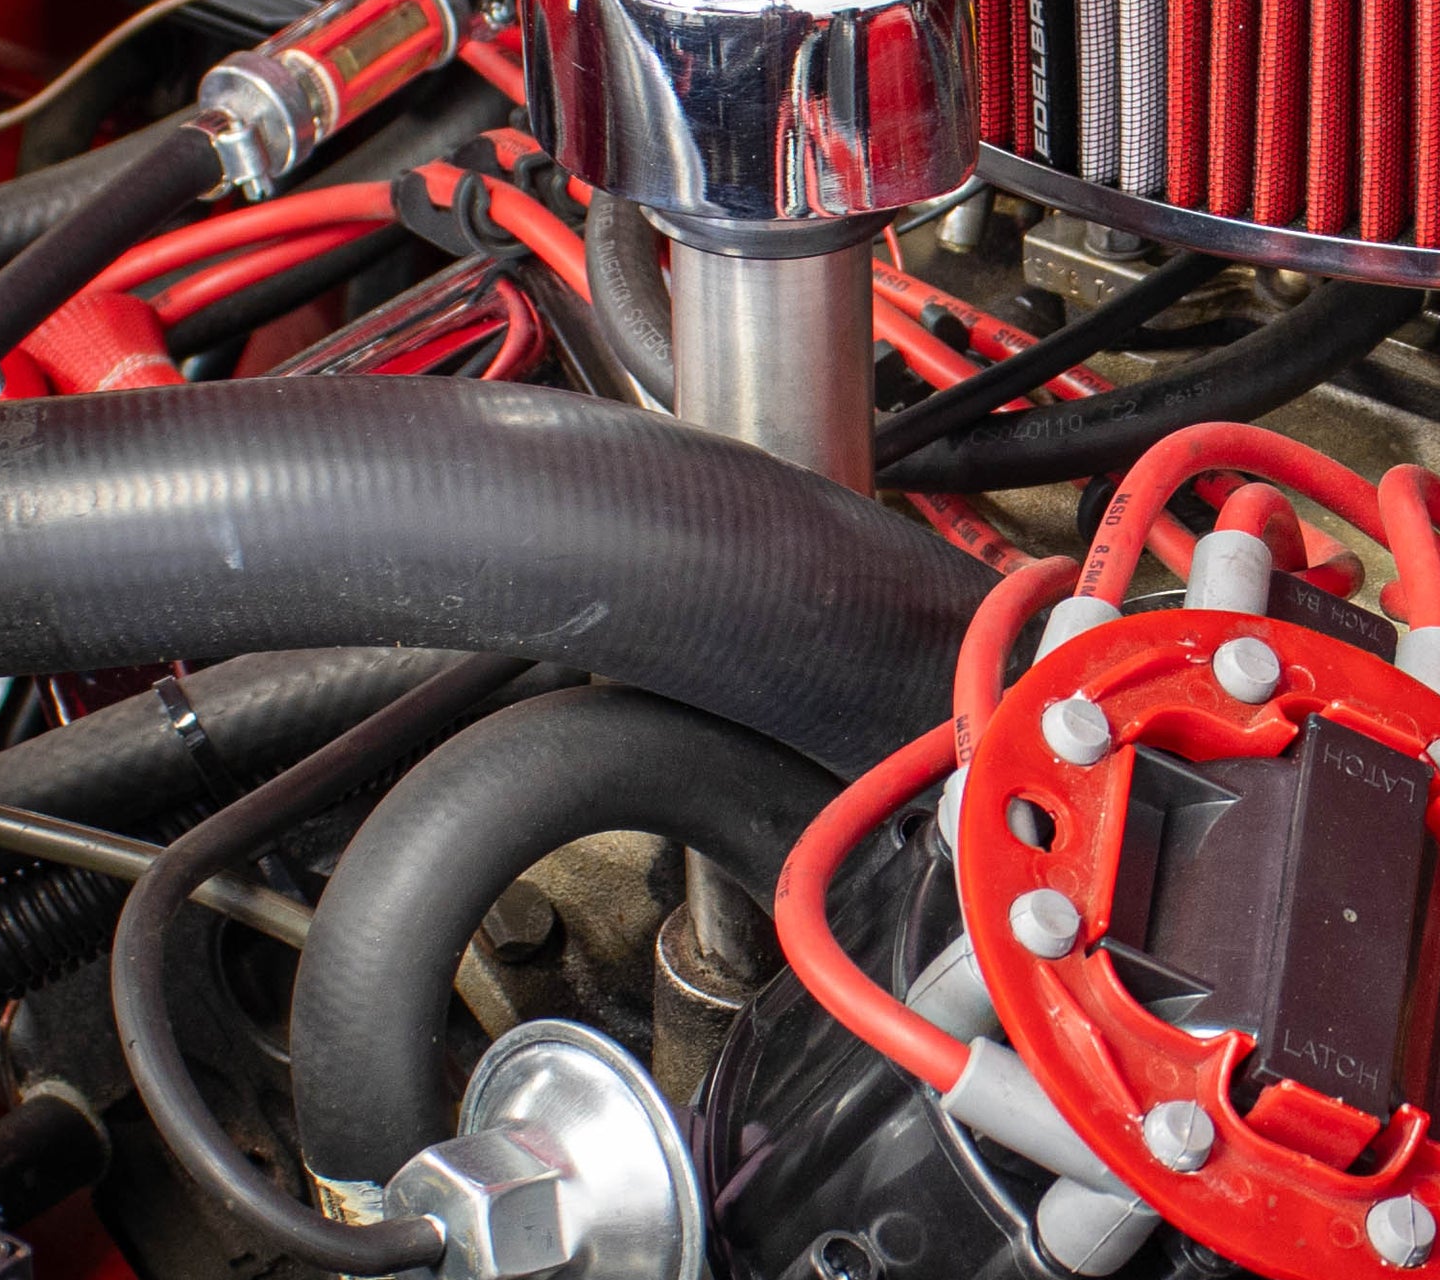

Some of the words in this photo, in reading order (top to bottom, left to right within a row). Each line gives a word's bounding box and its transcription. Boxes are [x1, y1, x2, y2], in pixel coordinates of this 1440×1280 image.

[873, 266, 910, 293] MSD
[1104, 493, 1132, 526] MSD
[1327, 602, 1384, 654] TACH
[954, 714, 973, 765] MSD
[1320, 742, 1418, 804] LATCH
[1283, 1029, 1381, 1090] LATCH
